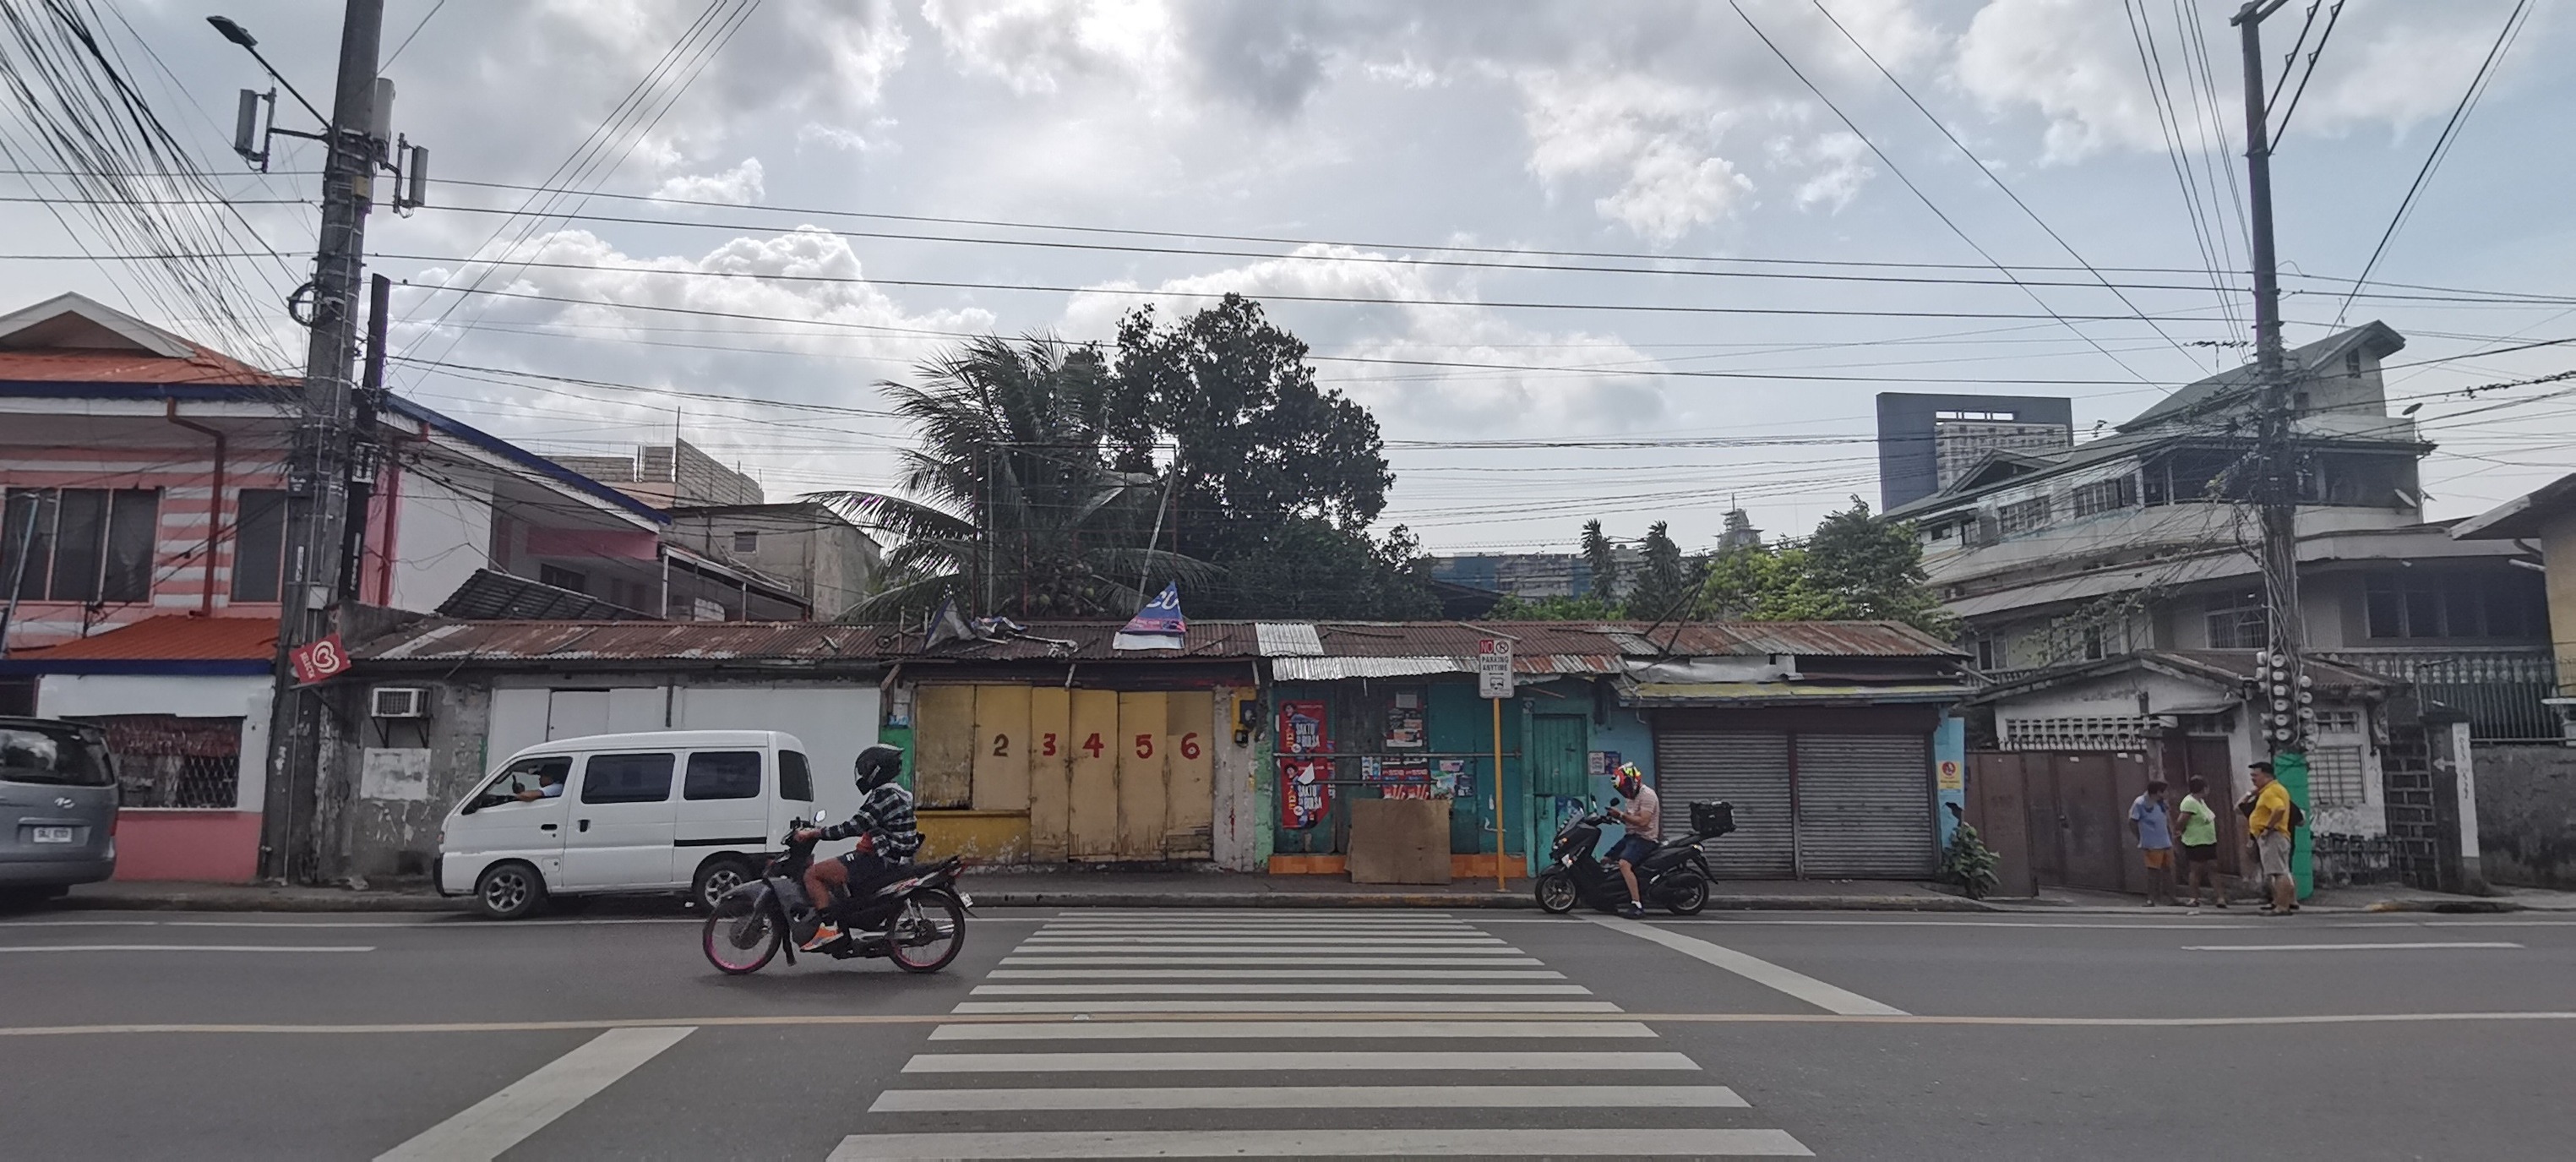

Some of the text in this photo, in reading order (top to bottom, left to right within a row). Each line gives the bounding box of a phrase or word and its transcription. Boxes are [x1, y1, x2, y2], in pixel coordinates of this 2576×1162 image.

[1480, 641, 1494, 653] NO
[299, 652, 316, 679] SELECTA
[1295, 723, 1315, 735] SAKTO
[992, 732, 1200, 759] 2 3 4 5 6
[1297, 784, 1317, 797] SAKTO
